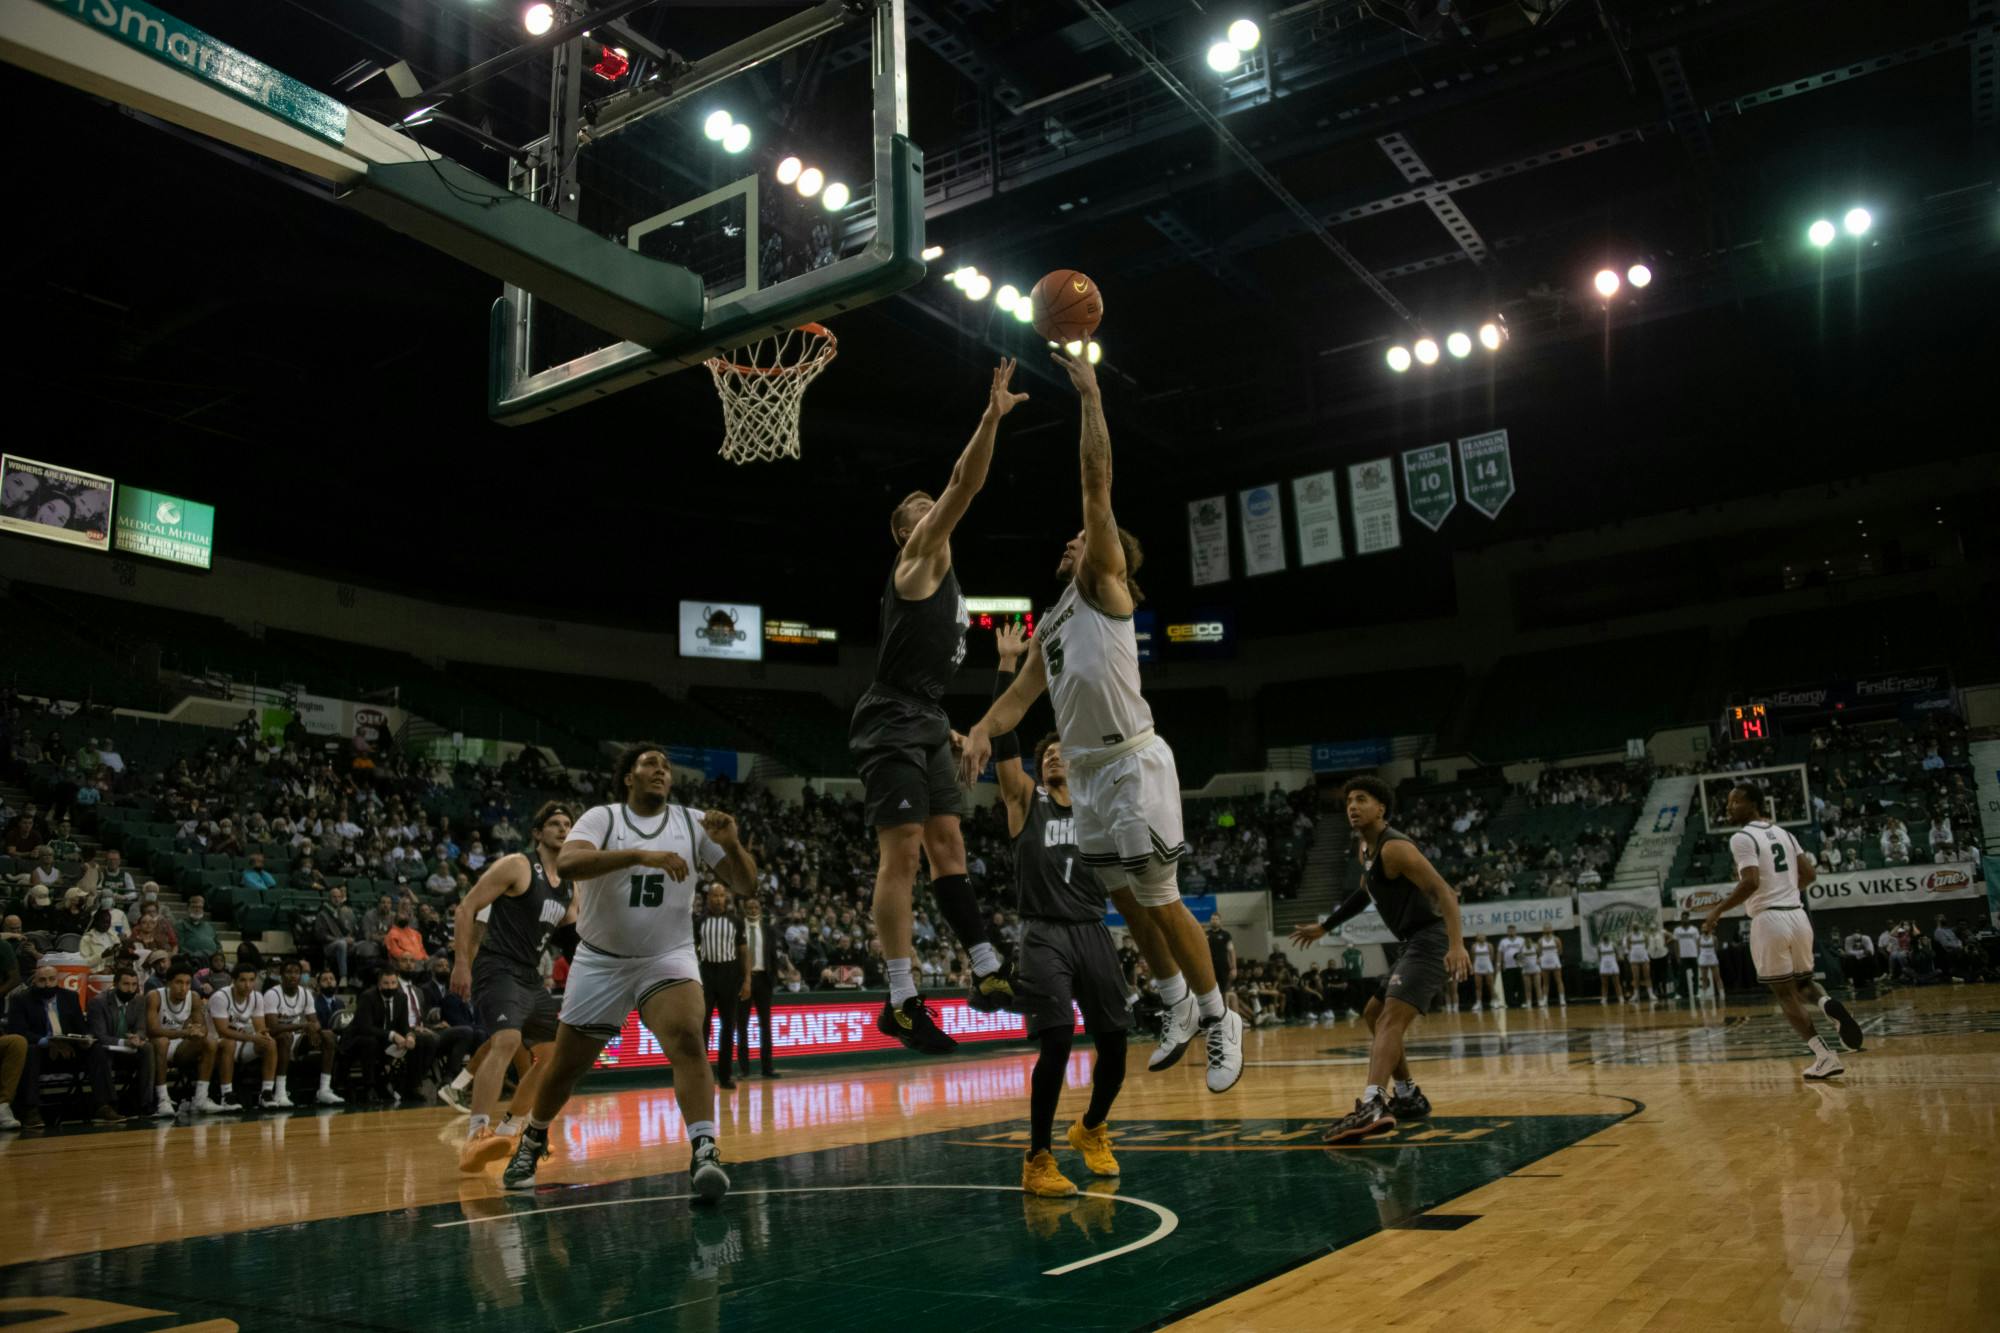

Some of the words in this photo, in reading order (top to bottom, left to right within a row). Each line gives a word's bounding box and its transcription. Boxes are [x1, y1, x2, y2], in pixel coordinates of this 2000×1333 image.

[1418, 451, 1436, 461] KEN
[8, 460, 43, 476] WINNERS
[44, 469, 59, 480] ARE
[1476, 460, 1498, 479] 14
[1420, 472, 1441, 491] 10
[119, 516, 167, 536] MEDICAL
[168, 527, 209, 545] MUTUAL
[779, 628, 801, 636] CHEVY
[803, 630, 836, 639] NETWORK
[1167, 622, 1223, 636] GEICO
[1856, 674, 1939, 697] FirstEnergy
[1743, 719, 1762, 739] 14
[1045, 818, 1079, 848] OHI
[1771, 843, 1788, 872] 2
[1064, 857, 1073, 884] 1
[629, 875, 664, 907] 15
[1809, 882, 1851, 900] OUS
[1858, 876, 1917, 895] VIKES
[1491, 906, 1564, 925] MEDICINE
[64, 976, 79, 992] G
[771, 1011, 864, 1047] CANE'S
